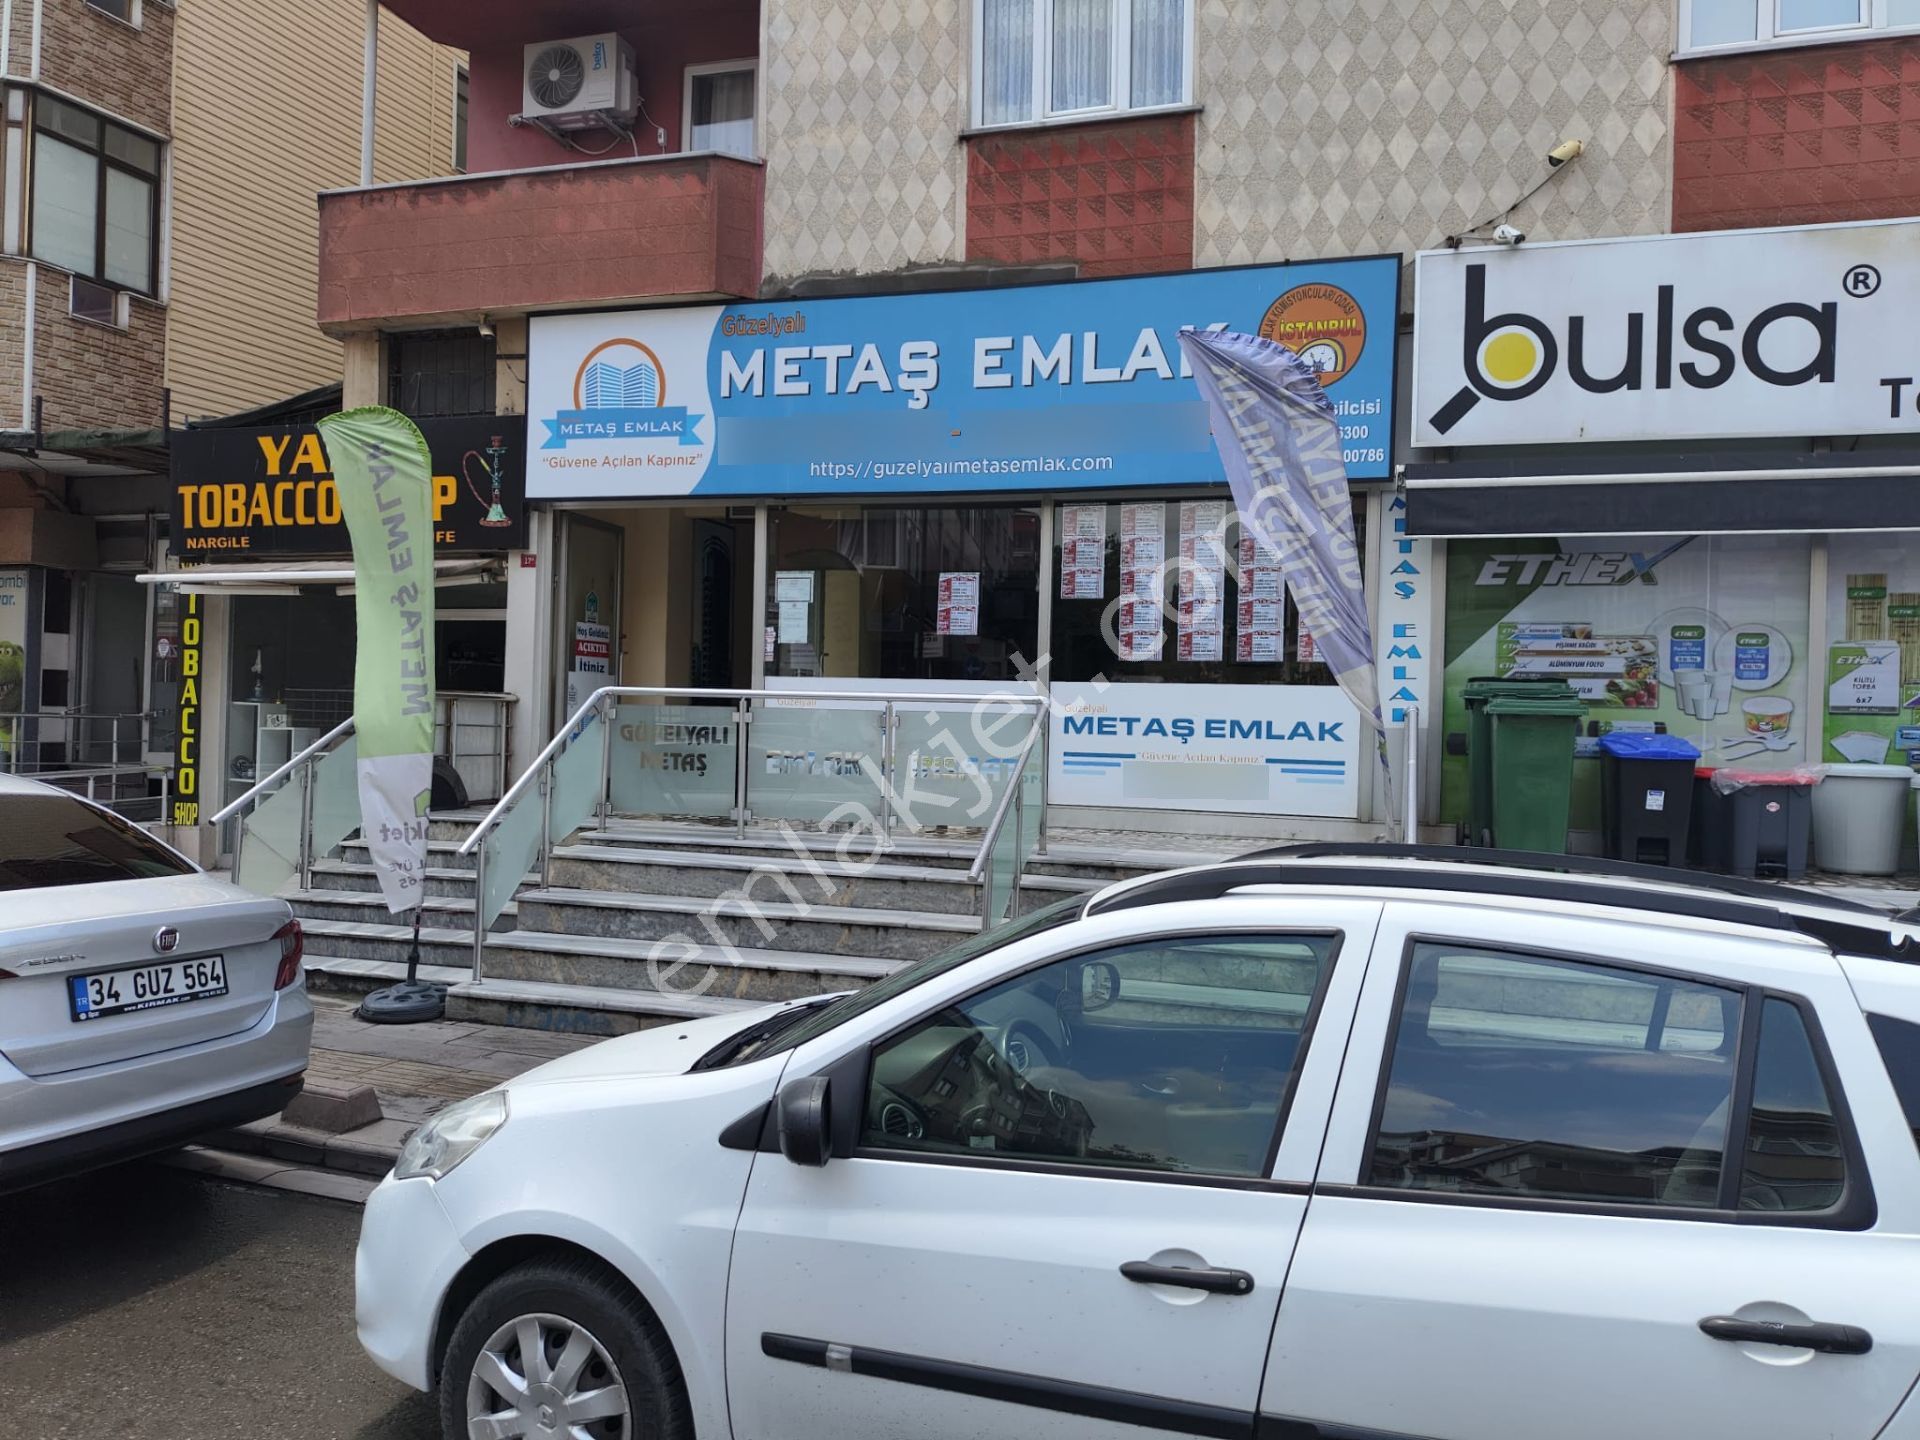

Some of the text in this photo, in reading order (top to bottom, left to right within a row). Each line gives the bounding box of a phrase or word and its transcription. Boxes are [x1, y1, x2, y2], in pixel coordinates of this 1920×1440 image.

[593, 41, 602, 70] beko
[722, 311, 805, 337] Güzelyalı
[1429, 263, 1838, 436] bulsa
[720, 341, 939, 410] METAŞ
[560, 420, 683, 438] METAŞ EMLAK
[602, 455, 642, 471] Açılan
[178, 479, 343, 529] TOBACCO
[1475, 545, 1680, 586] ETHEX
[1063, 715, 1345, 744] METAŞ EMLAK
[174, 801, 199, 826] SHOP
[89, 960, 222, 1006] 34 GUZ 564
[77, 997, 88, 1007] TR
